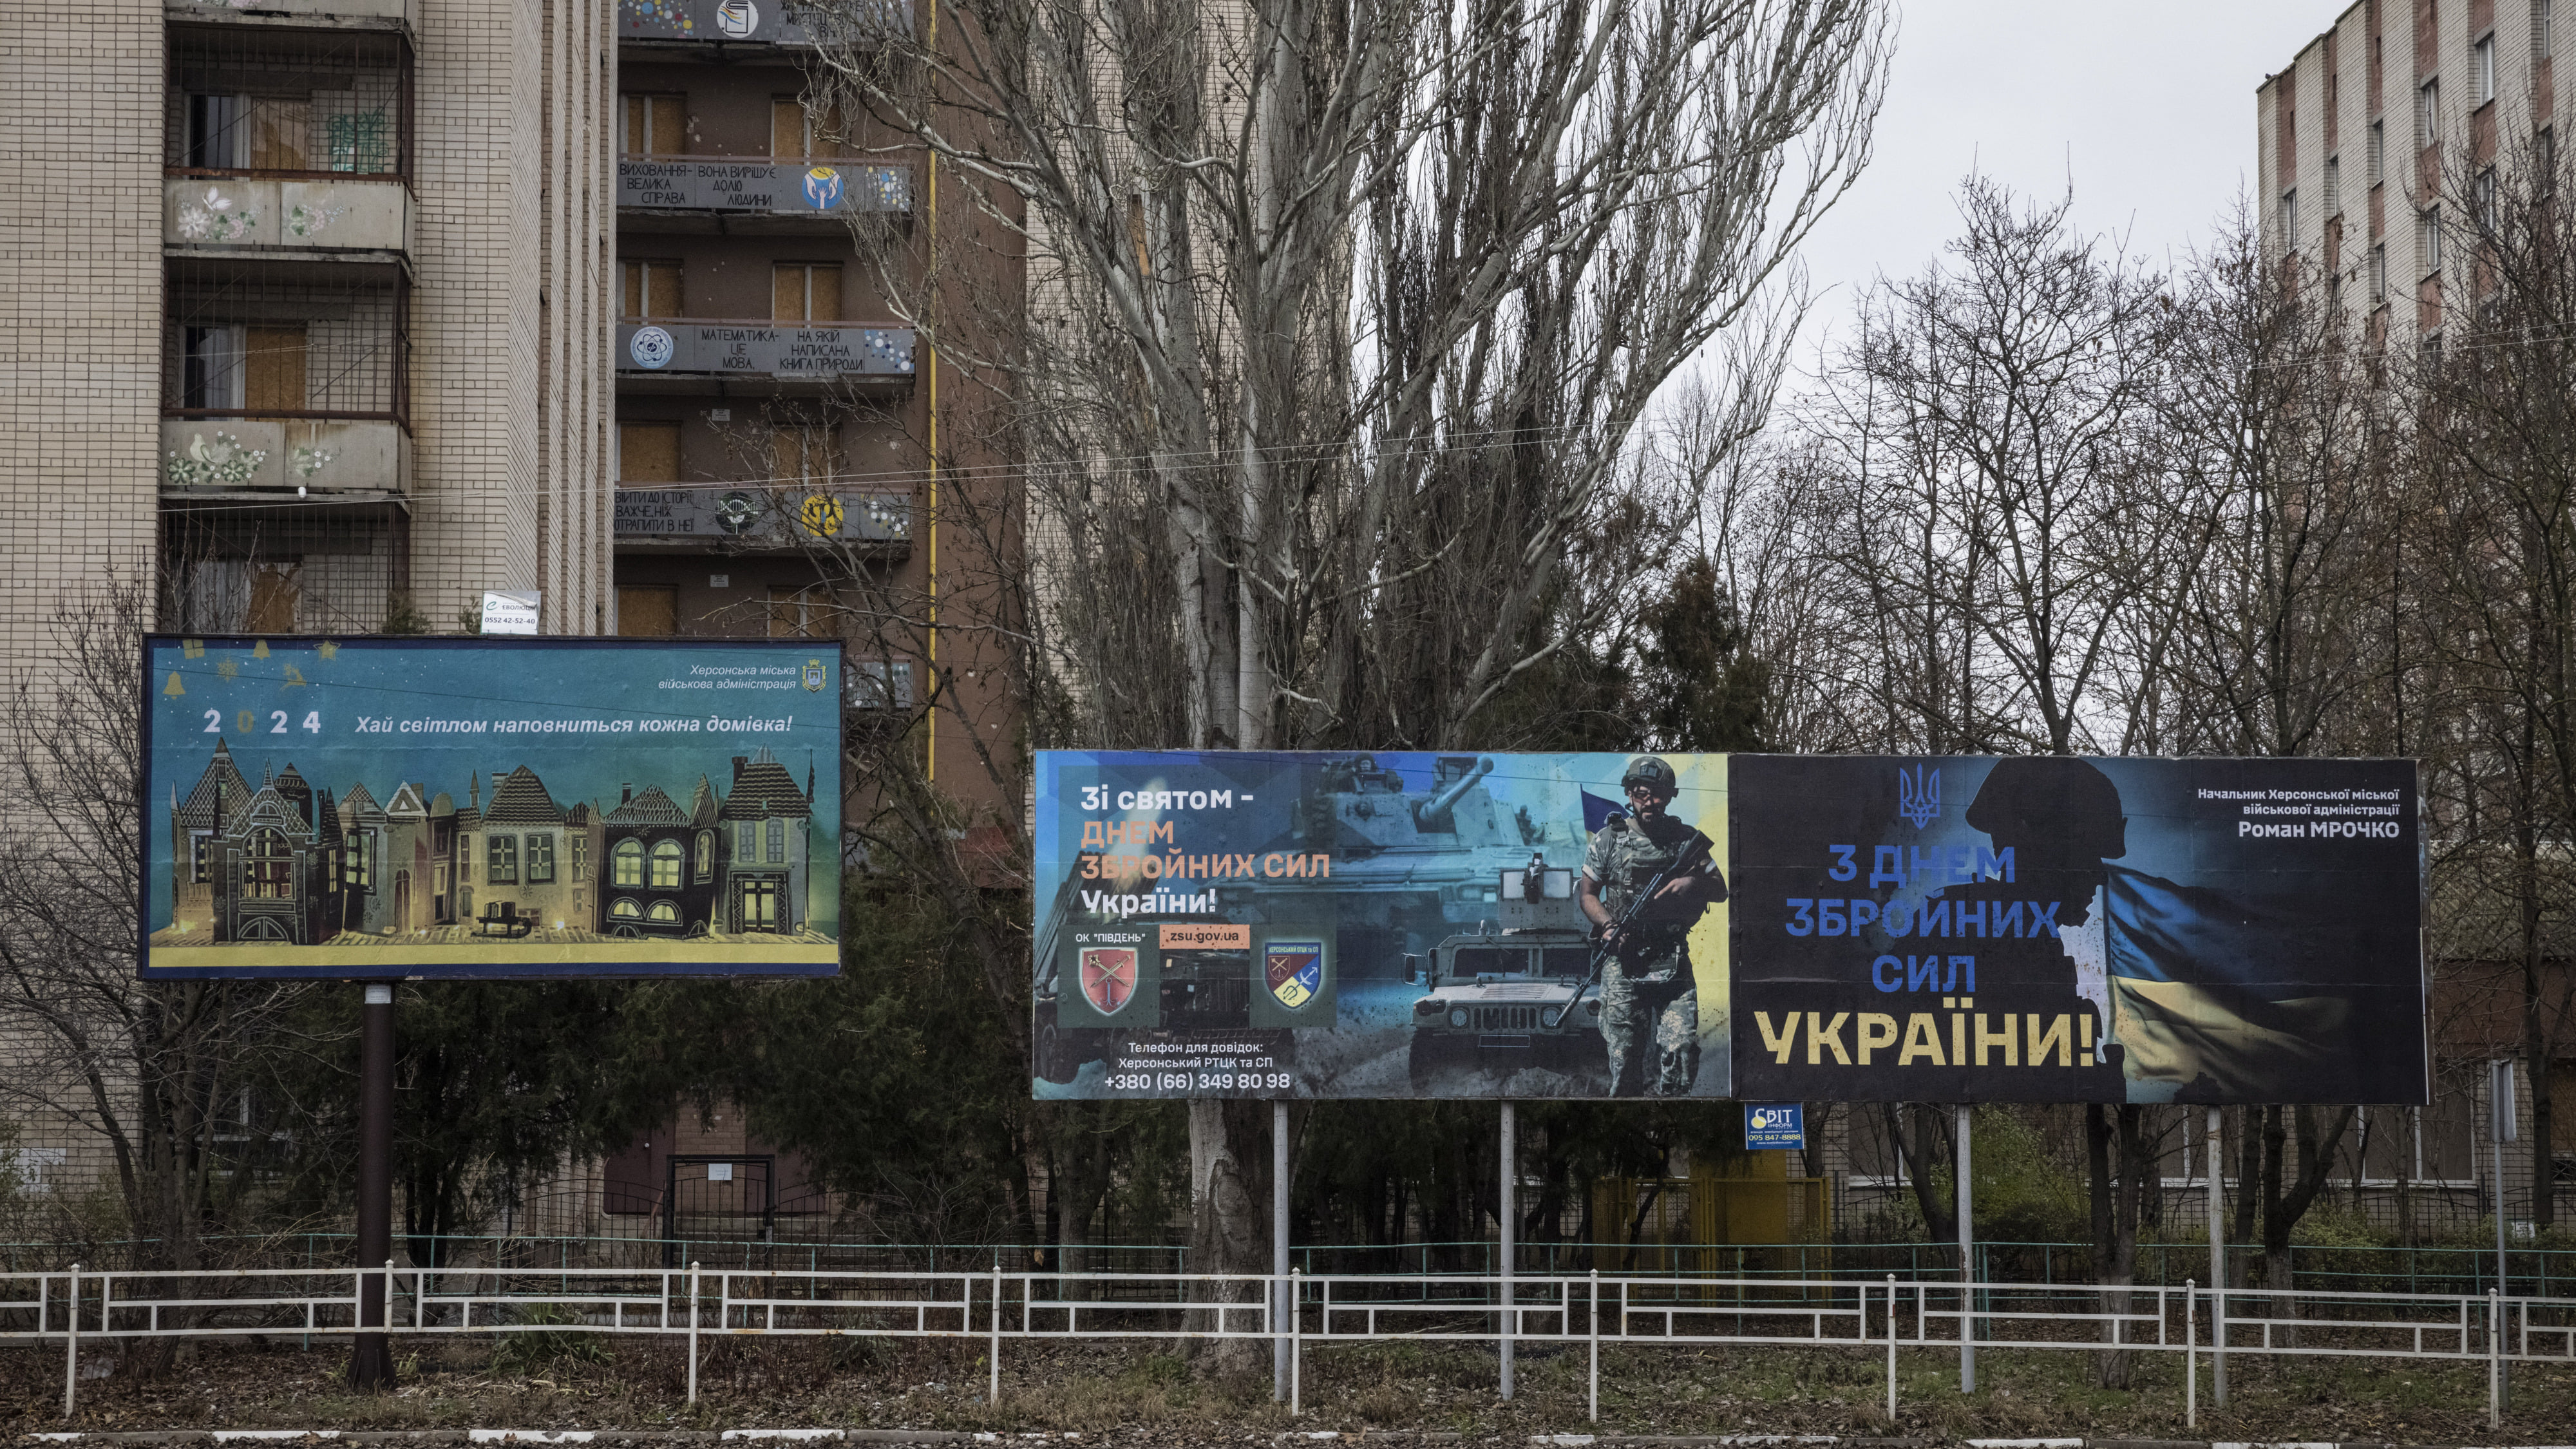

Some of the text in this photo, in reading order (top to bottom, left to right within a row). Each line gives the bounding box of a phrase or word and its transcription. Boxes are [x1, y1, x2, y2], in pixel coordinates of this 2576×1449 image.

[698, 166, 728, 178] ВОНА
[627, 178, 672, 189] ВЕЛИКА
[712, 180, 742, 192] ДОЛЮ
[641, 192, 686, 204] СПРАВА
[727, 194, 772, 207] ЛЮДИНИ
[797, 330, 812, 342] НА
[730, 343, 746, 356] ЦЕ
[791, 344, 850, 357] НАПИСАНА
[723, 356, 755, 370] МОВА,
[780, 357, 863, 371] КНИГА ПРИРОДИ
[648, 492, 659, 504] ДО
[616, 506, 672, 518] ВАЖЧЕ, НІЖ
[614, 518, 694, 532] ОТРАПИТИ В НЕЇ
[690, 665, 796, 677] Херсонська міська
[658, 678, 797, 690] військова адміністрація
[355, 715, 793, 733] Хай світлом наповниться кожна домівка!
[1081, 784, 1108, 811] Зі
[1119, 790, 1231, 810] святом
[2198, 789, 2400, 802] Начальник Херсонської міської
[2244, 804, 2400, 817] військової адміністрації
[1081, 820, 1173, 849] ДНЕМ
[2239, 822, 2400, 838] Роман МРОЧКО
[1081, 848, 1329, 880] ЗБРОЙНИХ СИЛ
[1829, 845, 2015, 889] З ДНЕМ
[1081, 887, 1215, 918] України!
[1786, 889, 2061, 938] ЗБРОЙНИХ
[1076, 933, 1146, 943] ОК "ПІВДЕНЬ"
[1170, 931, 1239, 945] zsu.gov.ua
[1872, 955, 1975, 992] СИЛ
[1755, 998, 2094, 1066] УКРАЇНИ!
[1128, 1042, 1263, 1055] Телефон для довідок:
[1119, 1057, 1273, 1070] Херсонський РТЦК та СП
[1105, 1072, 1290, 1091] +380 (66) 349 80 98
